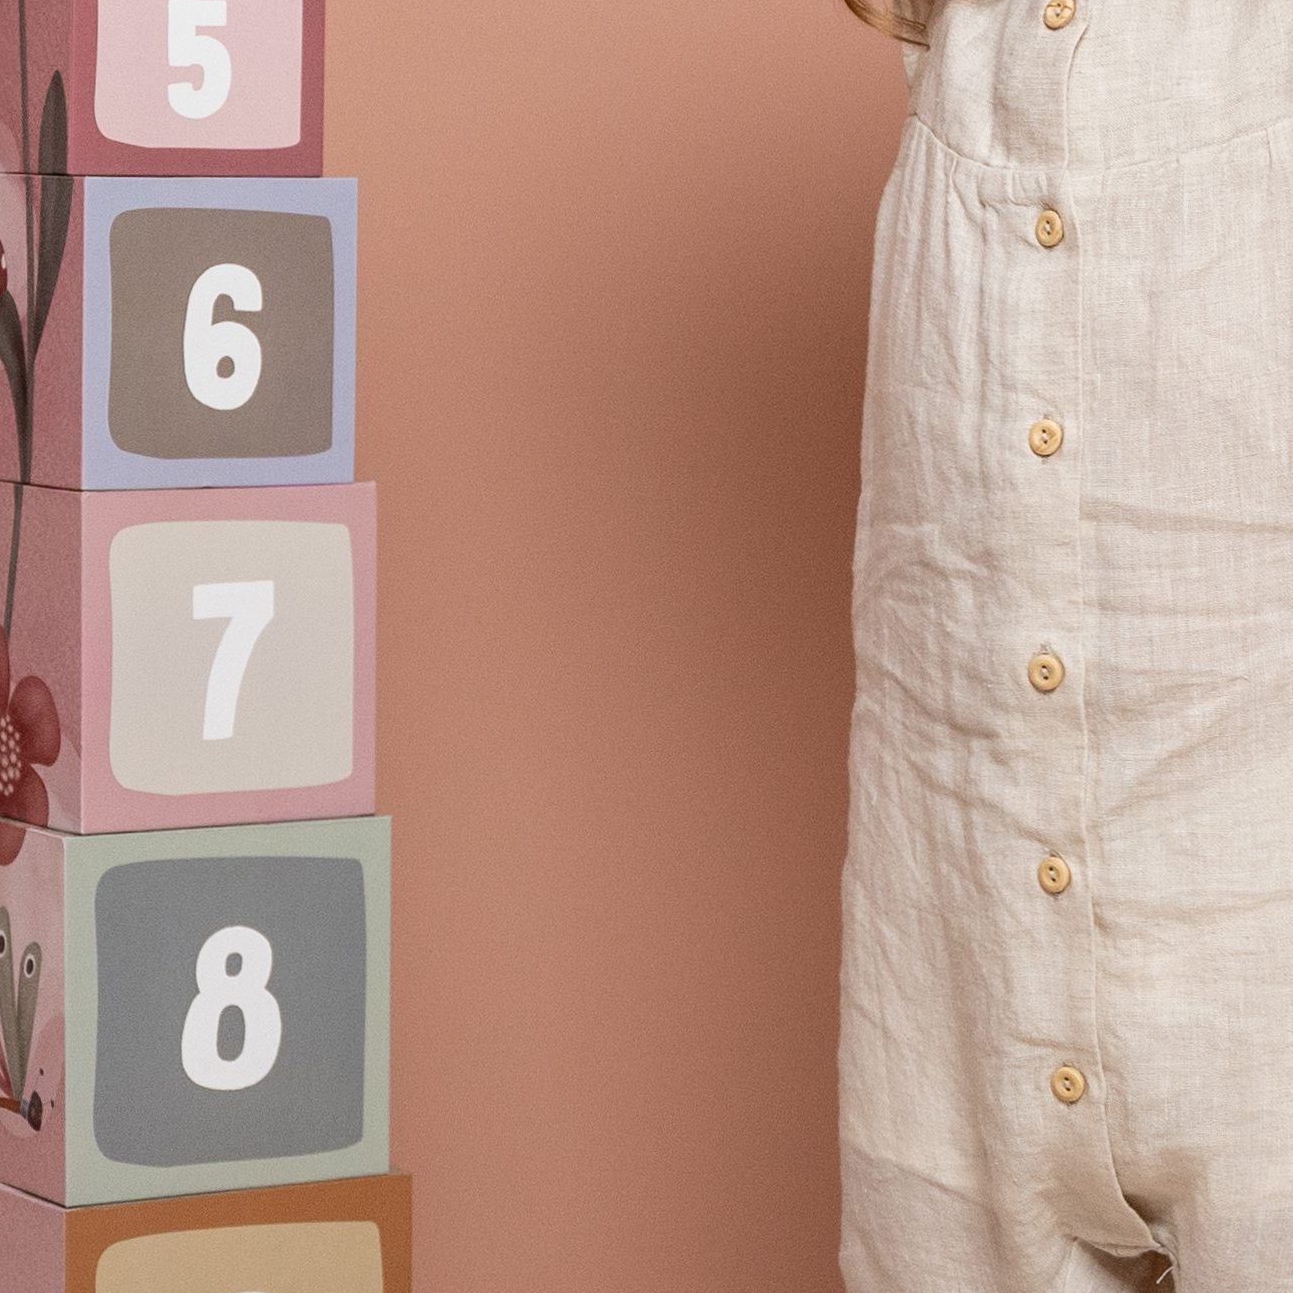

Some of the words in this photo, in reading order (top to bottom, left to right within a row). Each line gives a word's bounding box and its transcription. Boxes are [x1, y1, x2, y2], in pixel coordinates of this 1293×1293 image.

[183, 263, 263, 411] 6
[192, 579, 275, 740] 7
[181, 925, 282, 1091] 8
